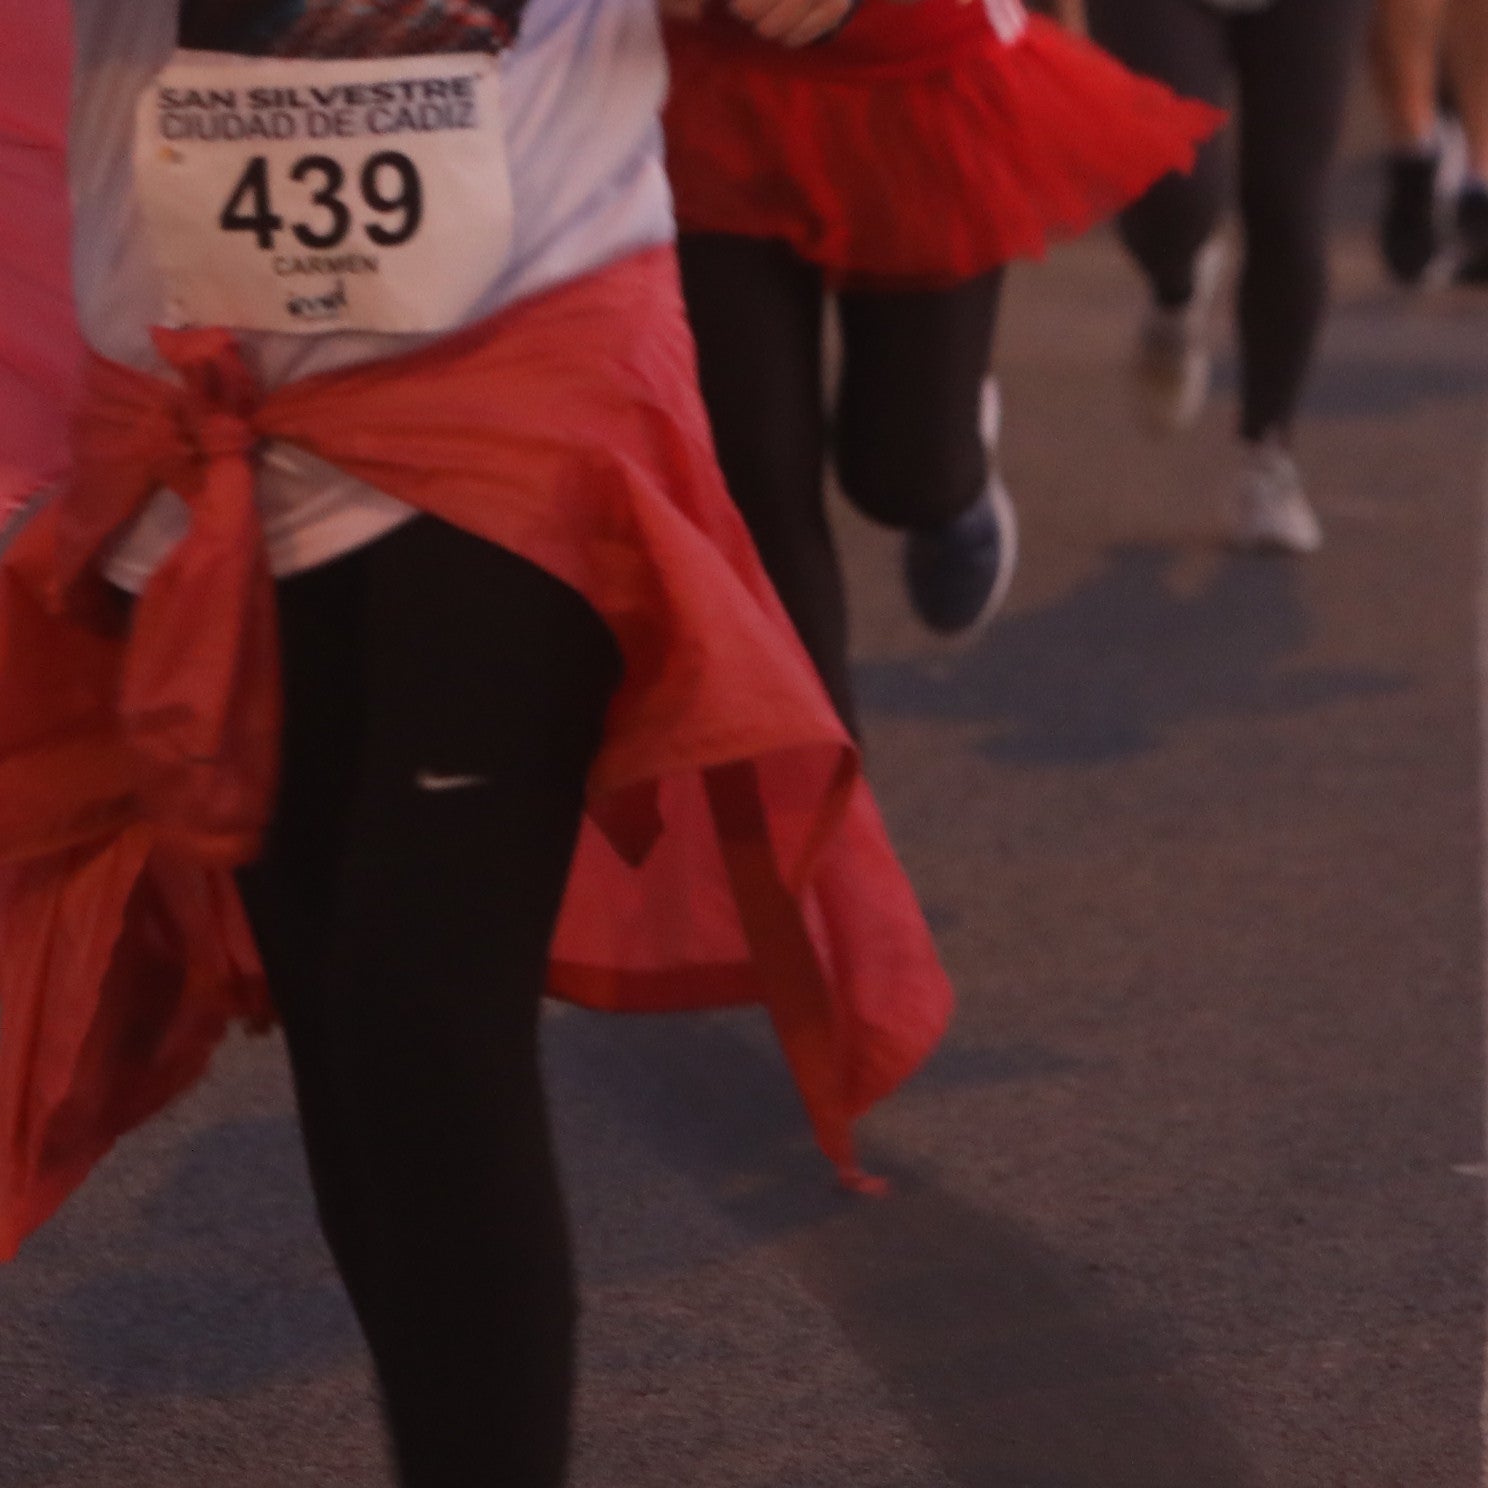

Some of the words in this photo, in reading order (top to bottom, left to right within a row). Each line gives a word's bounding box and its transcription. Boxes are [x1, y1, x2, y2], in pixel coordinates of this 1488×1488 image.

[158, 87, 237, 111] SAN
[247, 75, 474, 111] SILVESTRE
[160, 109, 299, 142] CIUDAD
[307, 110, 355, 140] DE
[219, 149, 424, 251] 439
[273, 254, 381, 277] CARMEN
